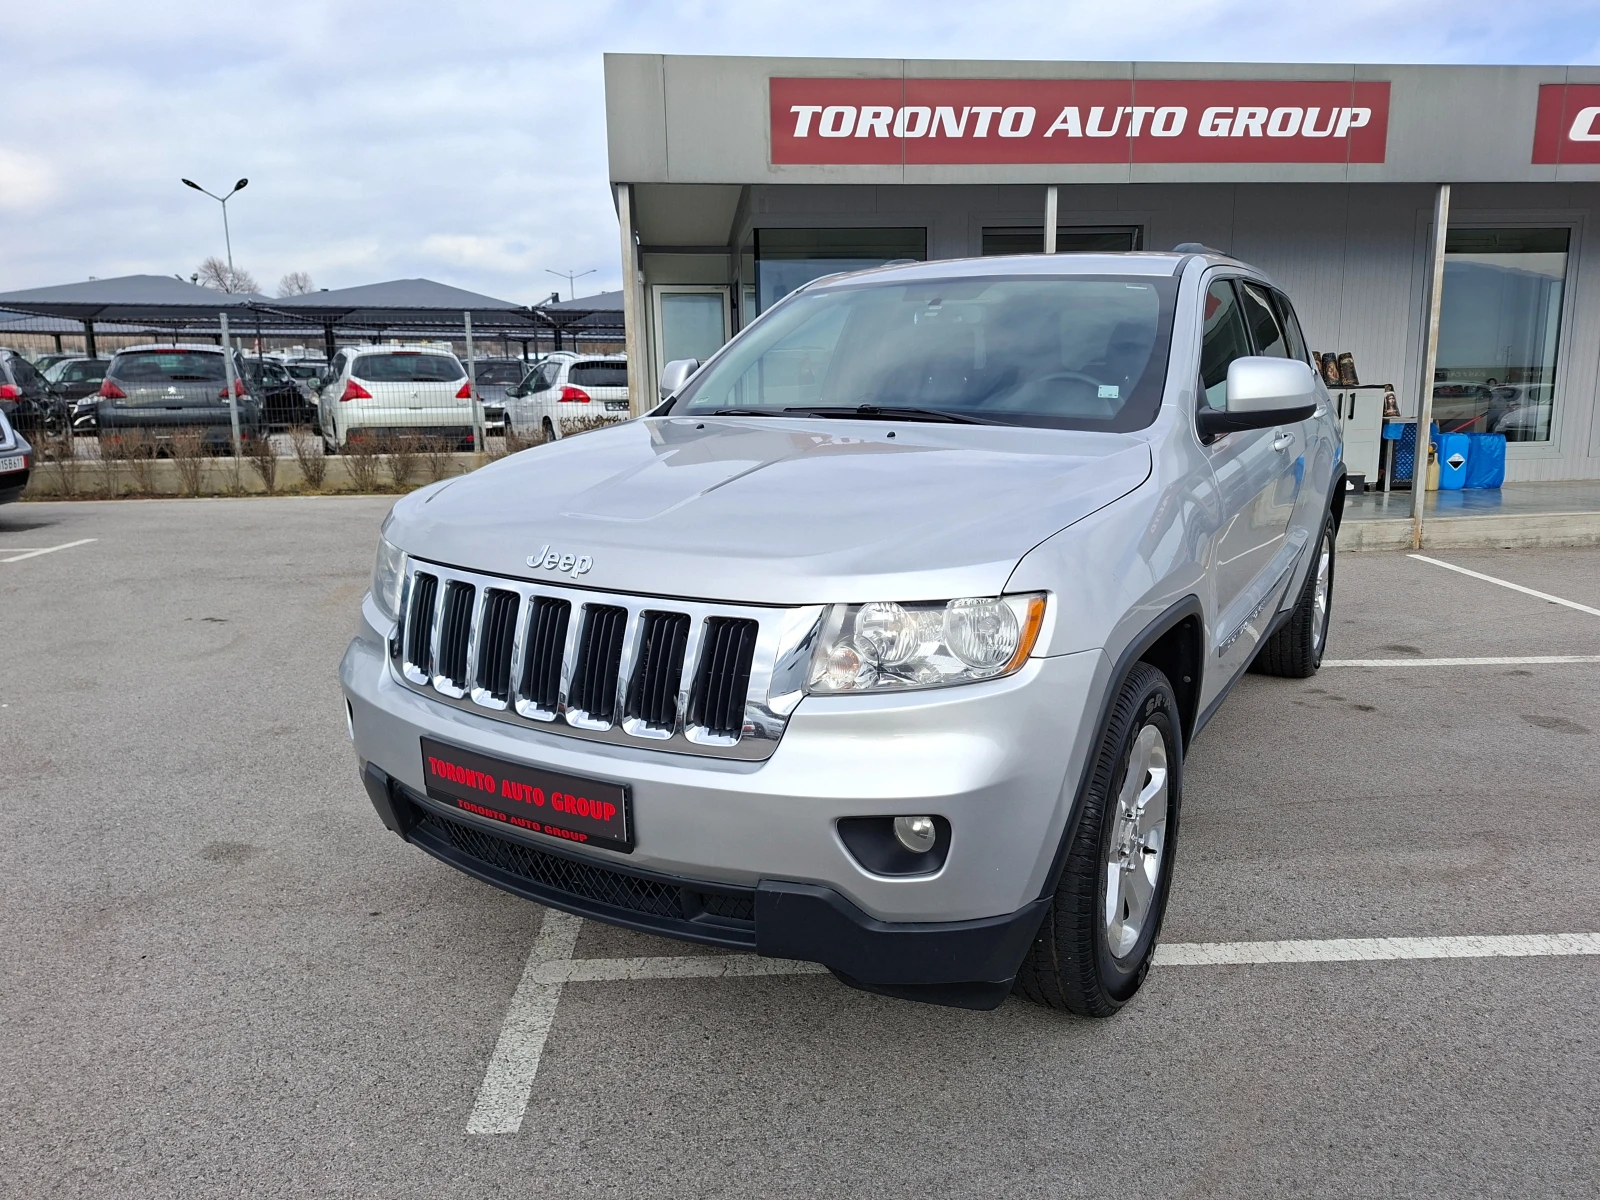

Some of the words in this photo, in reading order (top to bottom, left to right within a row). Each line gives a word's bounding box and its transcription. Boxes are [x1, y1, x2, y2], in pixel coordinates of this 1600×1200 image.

[789, 105, 1037, 138] TORONTO
[1043, 106, 1188, 138] AUTO
[1197, 106, 1372, 139] GROUP
[526, 544, 593, 579] Jeep
[428, 756, 497, 794] TORONTO
[501, 779, 546, 807] AUTO
[551, 791, 617, 822] GROUP
[457, 799, 507, 822] TORONTO
[510, 816, 541, 832] AUTO
[544, 825, 588, 842] GROUP
